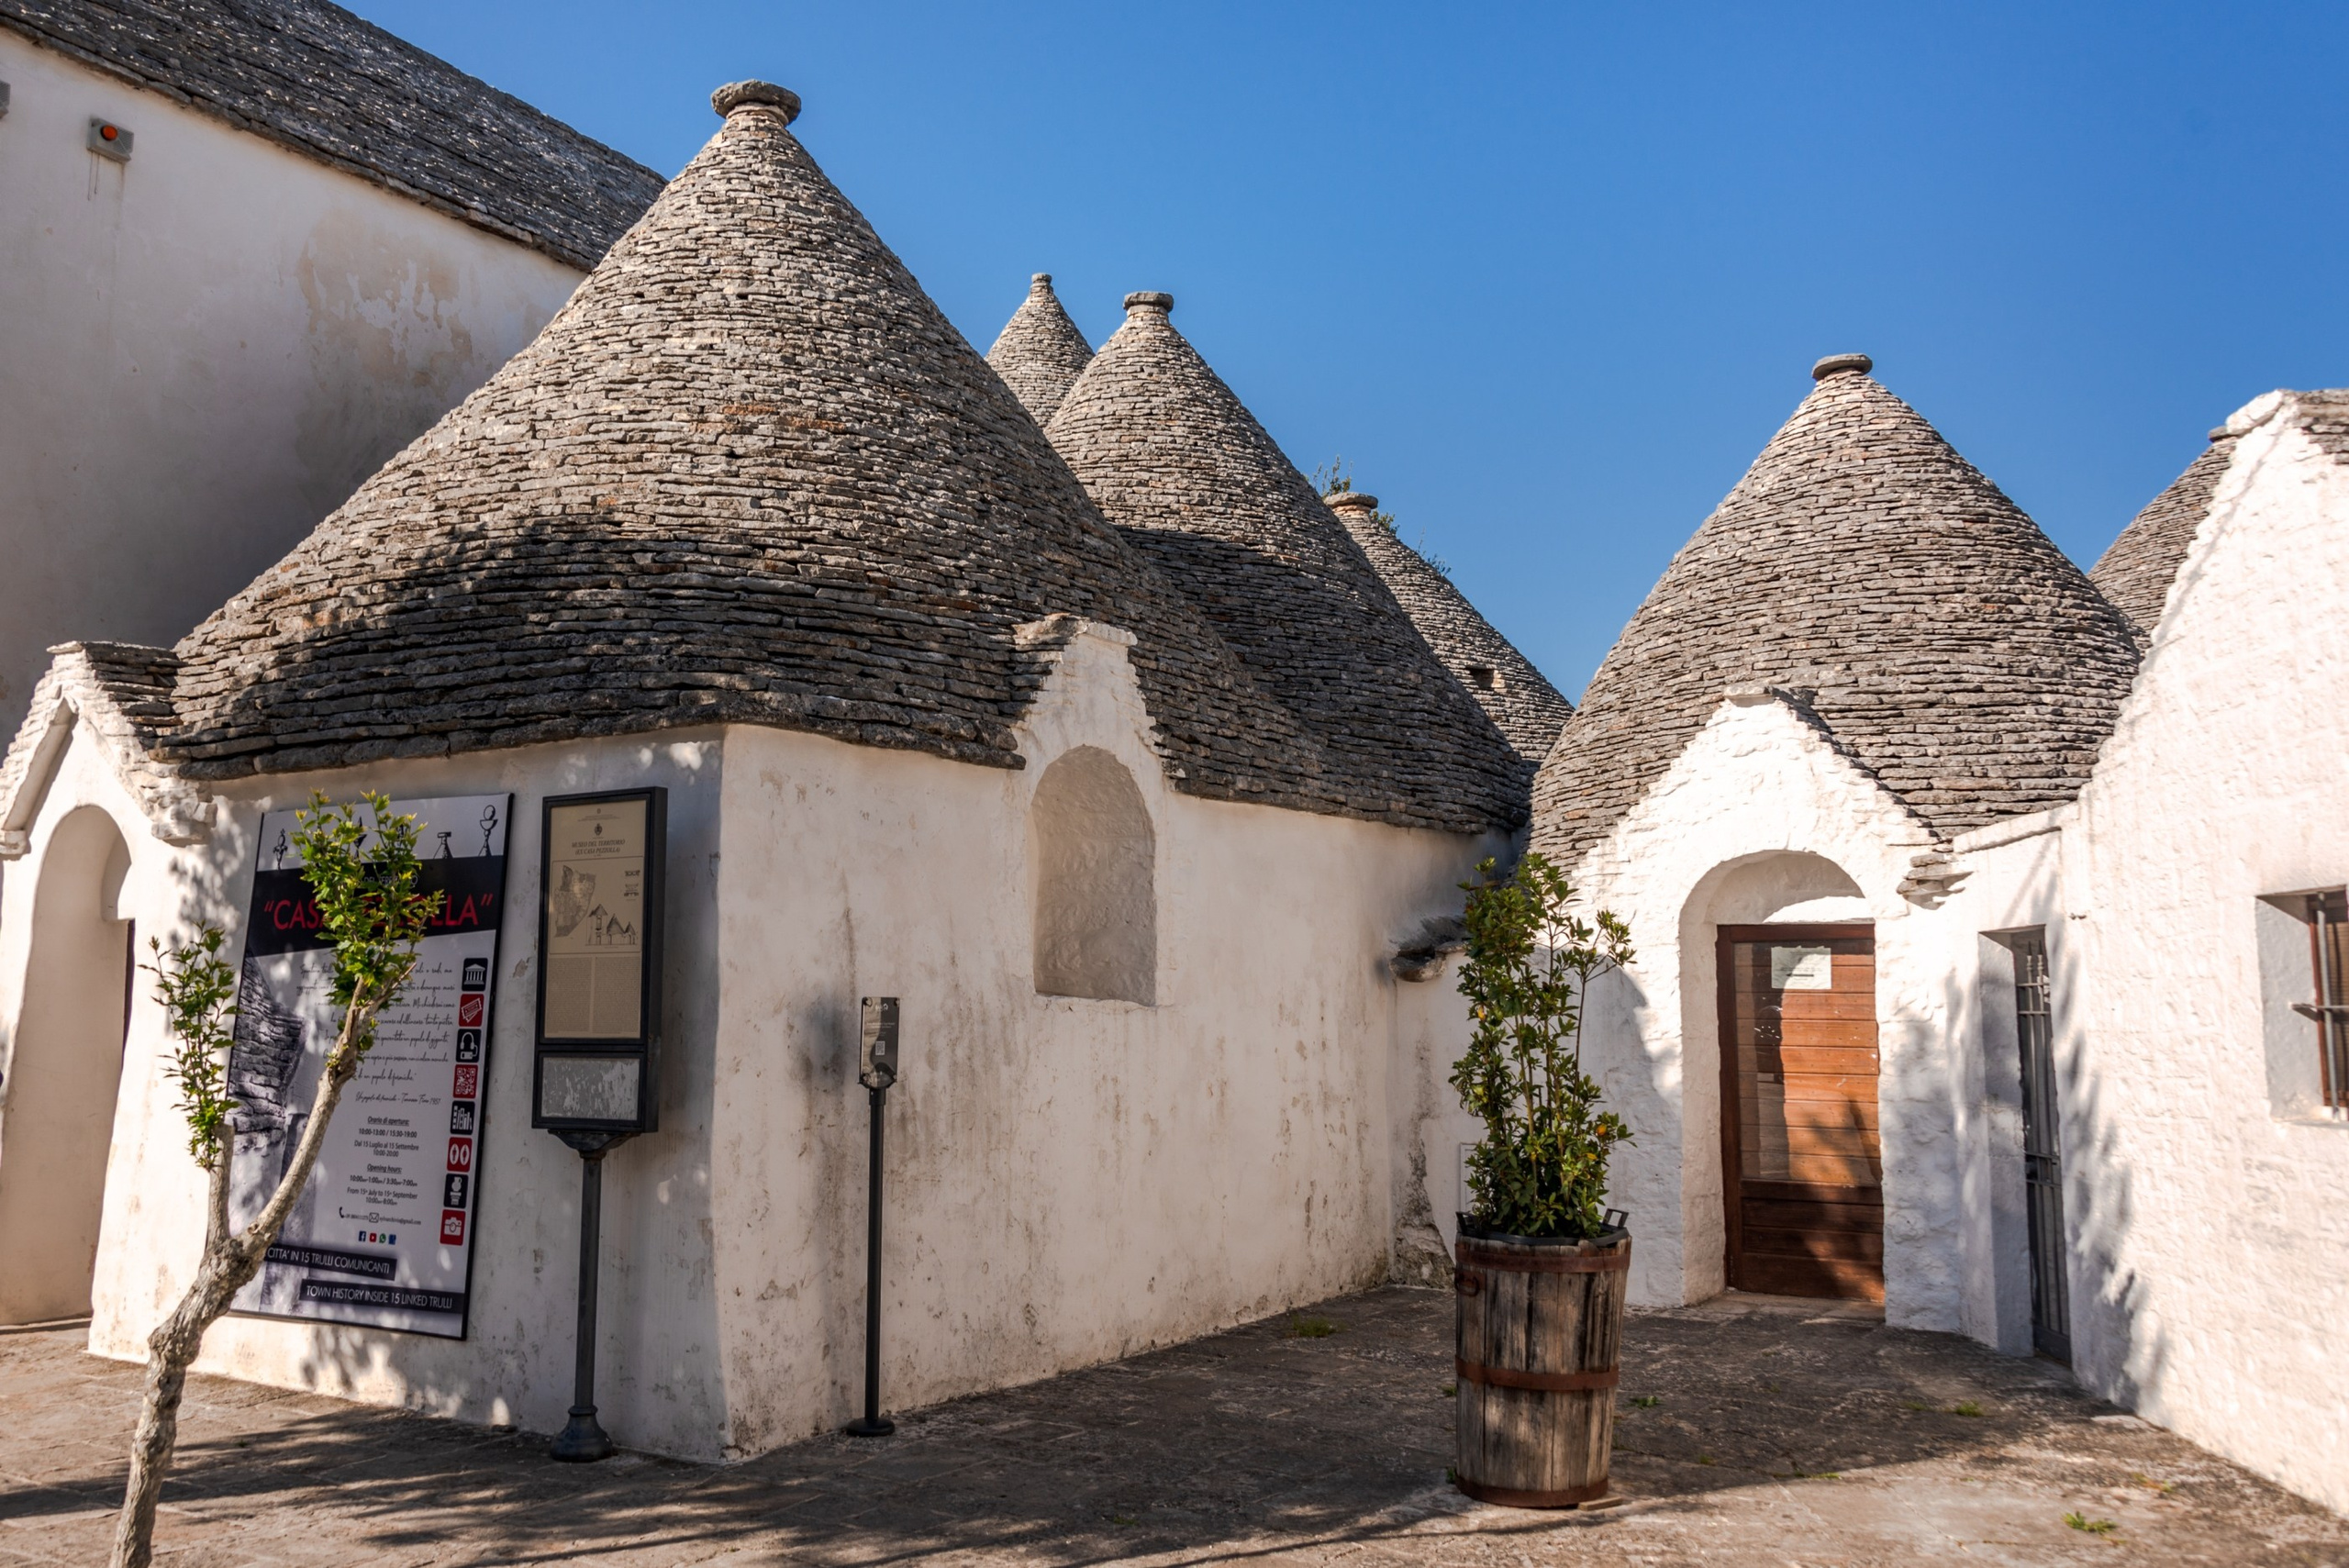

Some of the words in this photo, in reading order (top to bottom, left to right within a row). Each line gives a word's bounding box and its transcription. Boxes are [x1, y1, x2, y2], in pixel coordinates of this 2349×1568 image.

[367, 1116, 383, 1126] Orario
[383, 1117, 388, 1126] di
[388, 1118, 409, 1127] apertura:
[359, 1128, 385, 1137] 10:00-13:00
[389, 1129, 417, 1139] 15:30-19:00
[369, 1141, 384, 1150] Luglio
[389, 1142, 395, 1151] 15
[395, 1142, 419, 1151] Settembre
[367, 1163, 386, 1173] Opening
[387, 1165, 403, 1174] hours:
[347, 1186, 359, 1195] From
[368, 1188, 377, 1197] July
[392, 1191, 418, 1199] September
[290, 1250, 299, 1262] IN
[301, 1251, 309, 1263] 15
[311, 1252, 334, 1266] TRULLI
[334, 1255, 391, 1274] COMUNICANTI
[306, 1285, 331, 1297] TOWN
[332, 1287, 364, 1300] HISTORY
[364, 1290, 388, 1303] INSIDE
[391, 1293, 400, 1304] 15
[401, 1294, 428, 1307] LINKED
[429, 1295, 452, 1309] TRULLI
